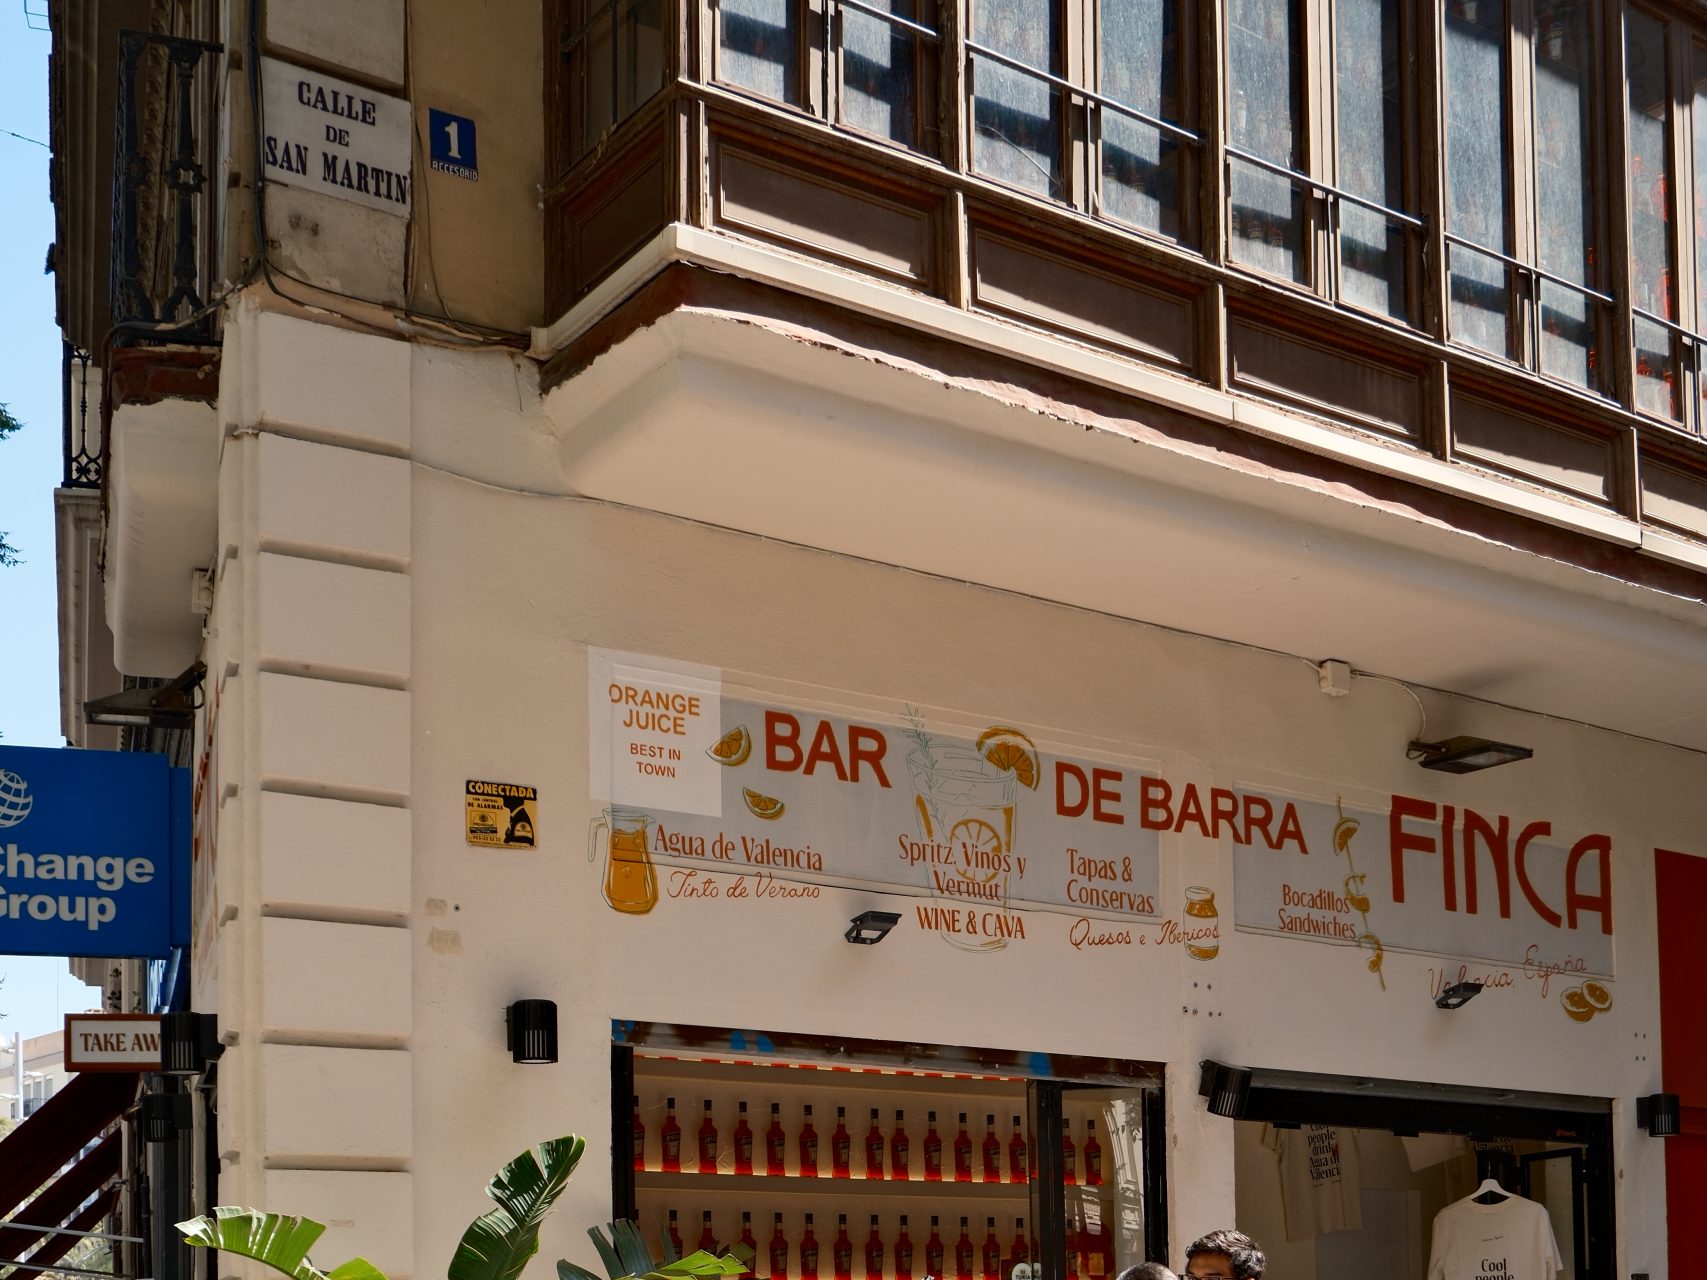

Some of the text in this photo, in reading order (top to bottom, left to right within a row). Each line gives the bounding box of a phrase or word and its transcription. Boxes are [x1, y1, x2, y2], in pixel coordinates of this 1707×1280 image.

[298, 80, 376, 127] CALLE
[325, 124, 349, 147] DE
[445, 121, 462, 159] 1
[265, 136, 408, 205] SAN MARTIN
[432, 160, 479, 182] ACCESORIO
[609, 682, 700, 716] ORANGE
[623, 709, 686, 735] JUICE
[630, 742, 681, 761] BEST IN
[636, 761, 676, 778] TOWN
[764, 709, 1309, 855] BAR DE BARRA
[468, 781, 534, 799] CONECTADA
[654, 824, 823, 872] Agua de Valencia
[962, 842, 1012, 873] Vinos
[1017, 857, 1026, 880] y
[0, 843, 155, 891] hange
[1066, 848, 1133, 883] Tapas &
[1389, 794, 1613, 936] FINCA
[667, 870, 820, 899] Tinto de Verano
[933, 870, 1001, 901] Vermut
[1066, 879, 1155, 915] Conservas
[1282, 884, 1351, 914] Bocadillos
[0, 885, 117, 931] roup
[916, 905, 1026, 940] WINE & CAVA
[1278, 908, 1357, 940] Sandwiches
[1069, 918, 1132, 951] Quesos
[1139, 935, 1147, 946] e
[80, 1033, 162, 1052] TAKE AW
[1481, 1258, 1507, 1272] Cool
